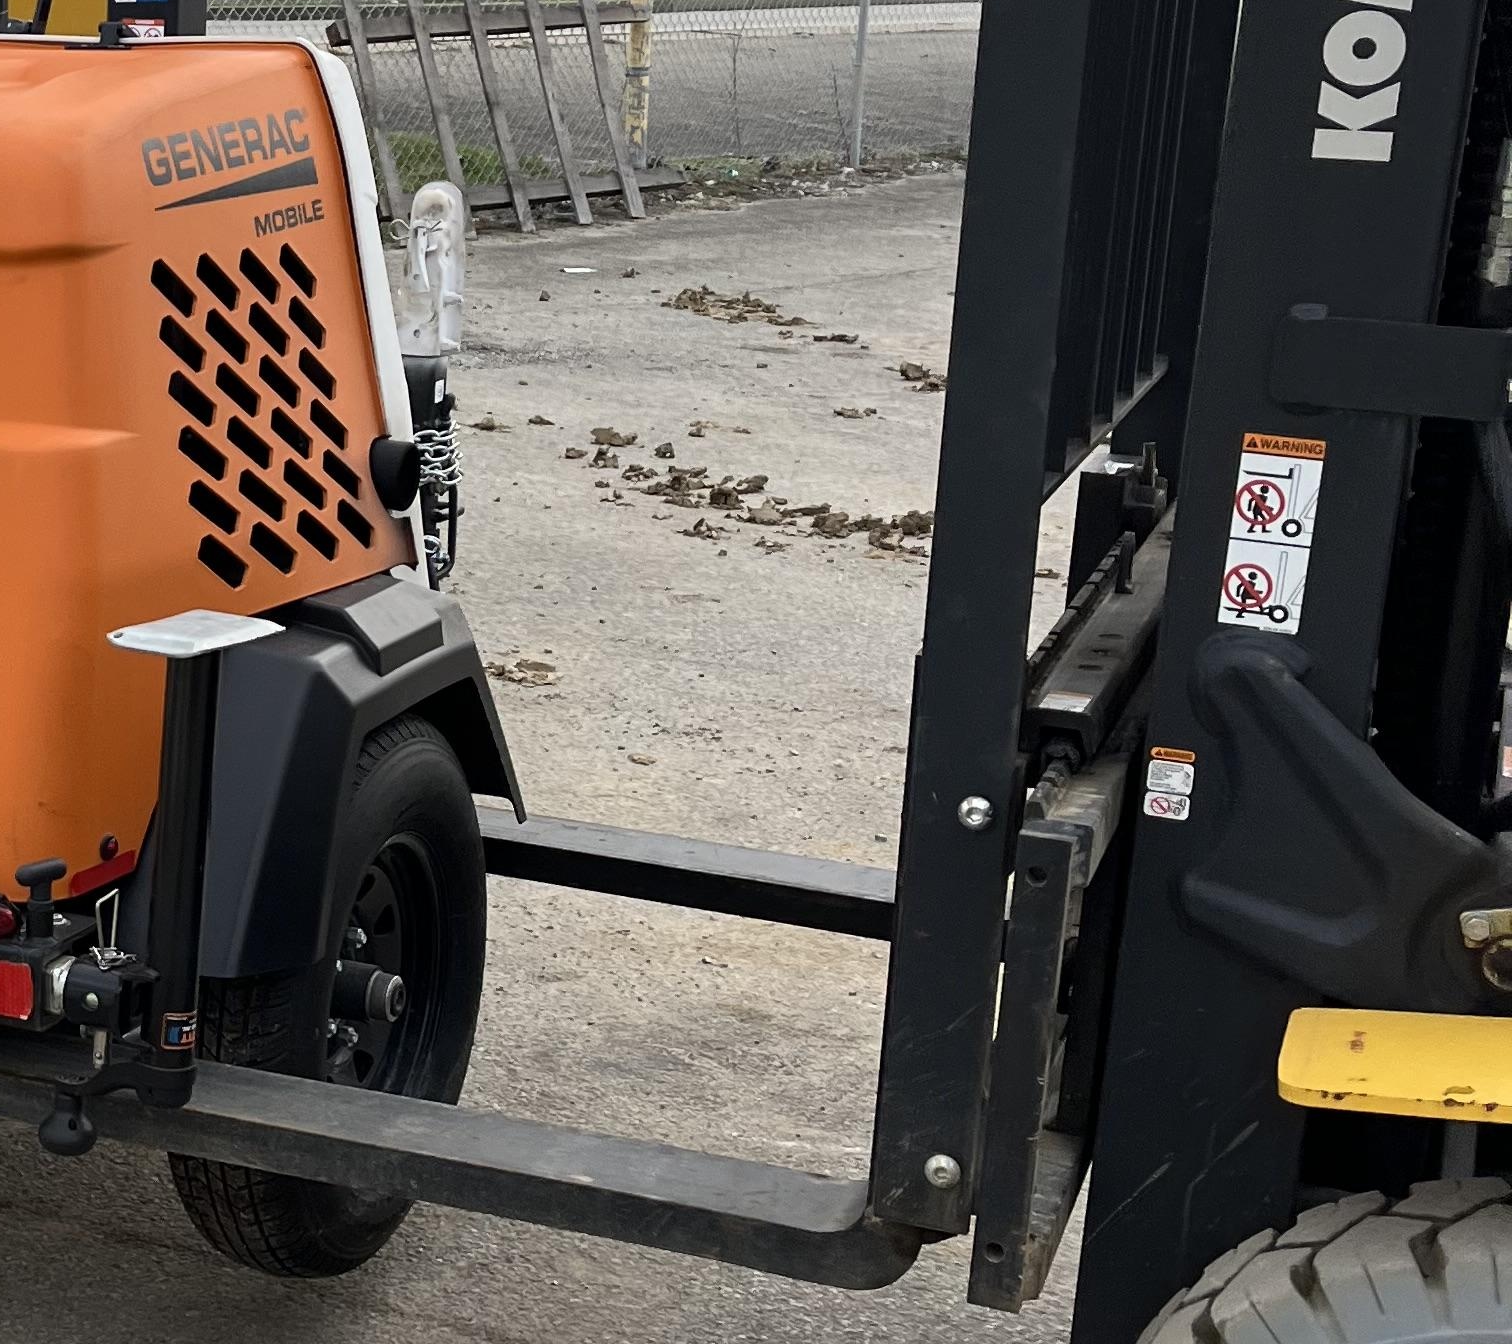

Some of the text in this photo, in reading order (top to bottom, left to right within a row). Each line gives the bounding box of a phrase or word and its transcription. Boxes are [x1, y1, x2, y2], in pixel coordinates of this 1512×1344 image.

[141, 109, 310, 187] GENERAC
[253, 199, 325, 238] MOBILE
[1260, 436, 1325, 457] WARNING
